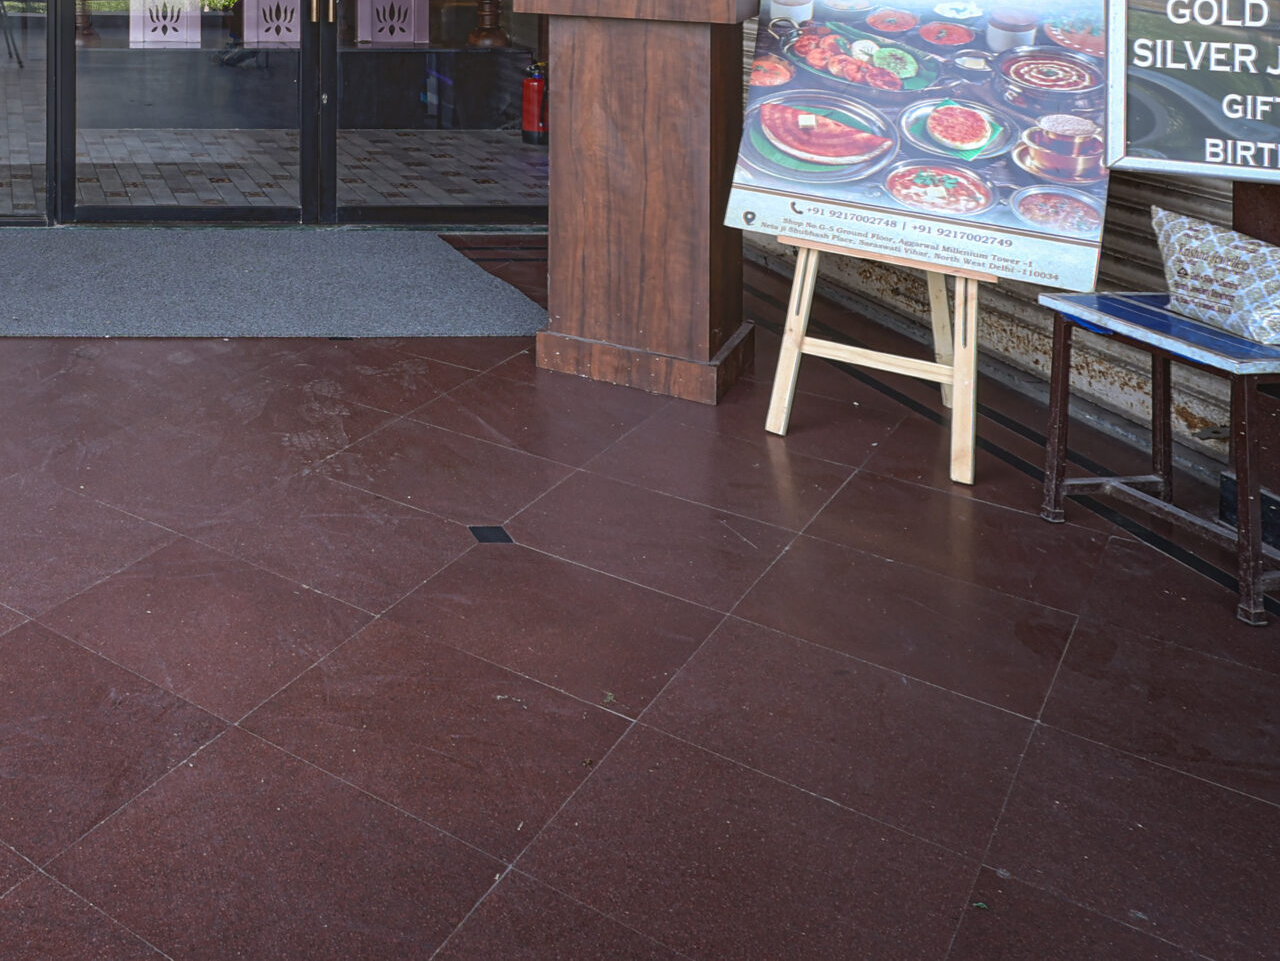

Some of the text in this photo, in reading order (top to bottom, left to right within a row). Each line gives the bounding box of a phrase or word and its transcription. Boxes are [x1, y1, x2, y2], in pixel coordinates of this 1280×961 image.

[1132, 38, 1258, 74] SILVER
[1204, 138, 1280, 167] BIRT
[783, 218, 804, 227] Shop
[836, 227, 868, 238] Ground
[871, 233, 896, 244] Floor,
[898, 238, 939, 252] Aggarwal
[941, 245, 988, 259] Millenium
[991, 254, 1020, 266] Tower
[807, 206, 825, 215] +91
[829, 210, 897, 228] 9217002748
[912, 224, 932, 234] +91
[937, 228, 1013, 248] 9217002749
[934, 253, 960, 263] North
[962, 257, 986, 268] West
[988, 262, 1014, 273] Delhi
